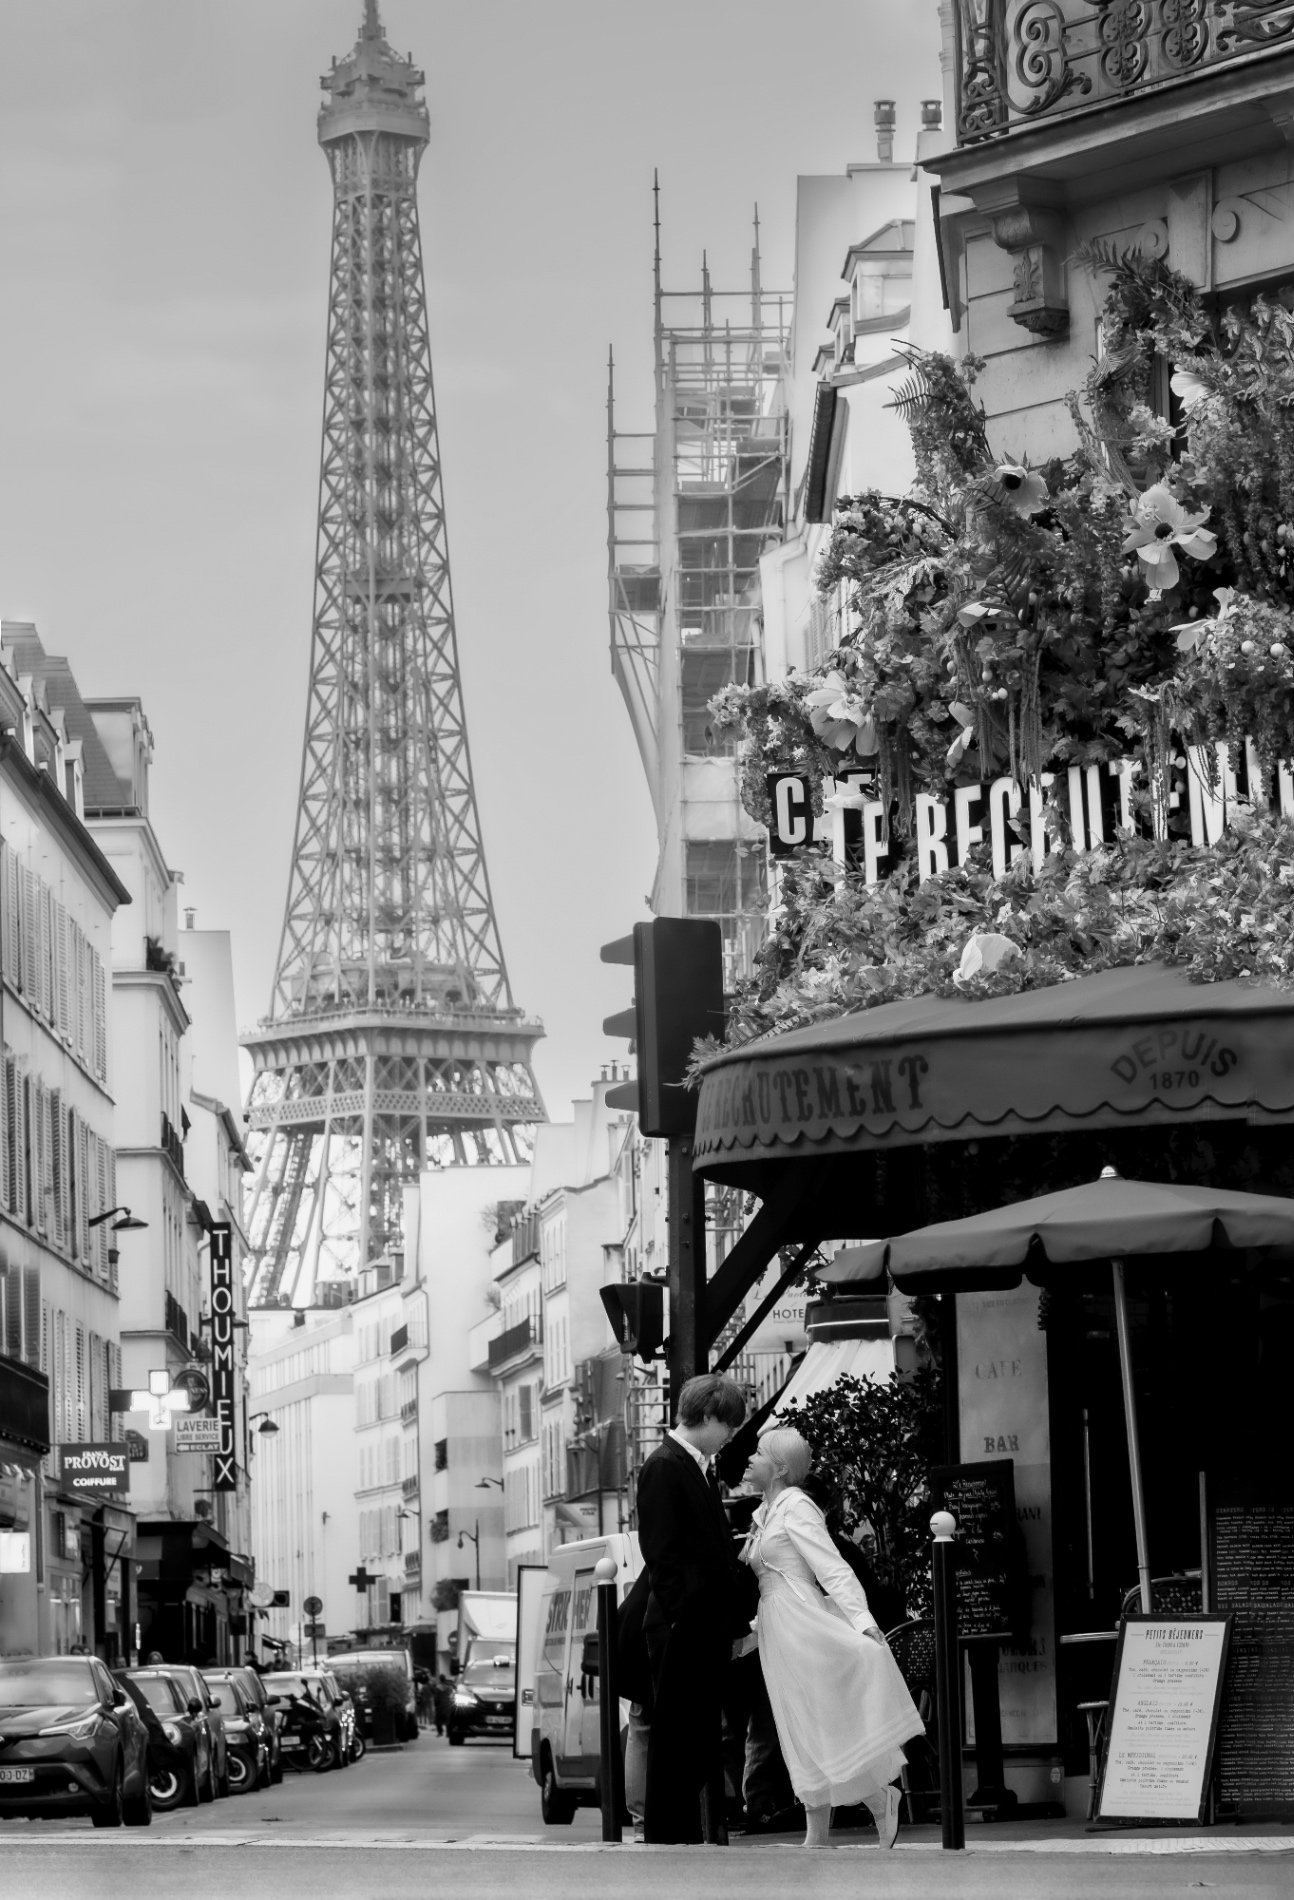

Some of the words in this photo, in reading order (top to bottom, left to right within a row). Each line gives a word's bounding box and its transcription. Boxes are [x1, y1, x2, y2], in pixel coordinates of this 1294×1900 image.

[1110, 1030, 1238, 1085] DEPUIS
[1150, 1070, 1200, 1090] 1870
[772, 1308, 805, 1319] HOTE
[212, 1231, 235, 1484] THOUMIEUX
[177, 1420, 219, 1432] LAVERIE
[190, 1443, 219, 1451] ECLAT
[983, 1435, 1020, 1453] BAR
[64, 1455, 126, 1469] PROVOST
[73, 1477, 117, 1487] COIFFURE
